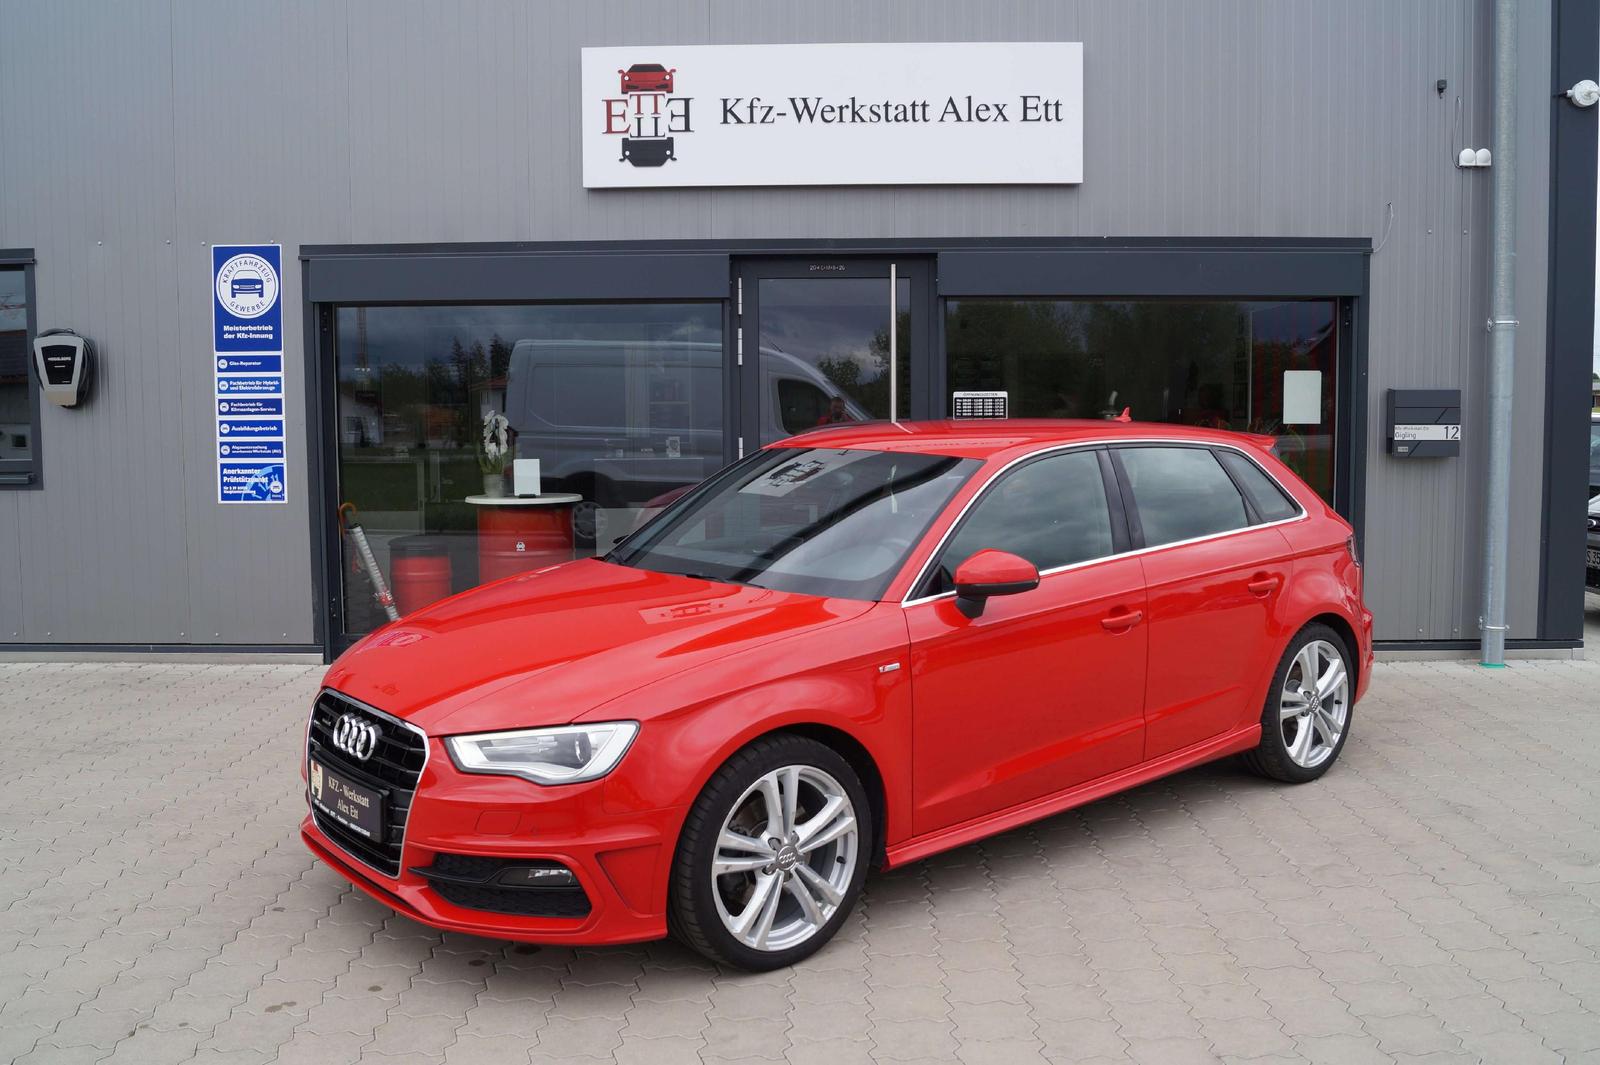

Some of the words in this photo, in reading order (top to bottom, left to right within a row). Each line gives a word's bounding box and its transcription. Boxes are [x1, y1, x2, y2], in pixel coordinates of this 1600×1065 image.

[720, 96, 930, 125] Kfz-Werkstatt
[938, 96, 1009, 123] Alex
[1019, 95, 1064, 122] Ett
[222, 260, 273, 284] KRAFTFAHRZEUG
[230, 301, 266, 312] GEWERBE
[1444, 426, 1459, 439] 12
[328, 776, 339, 793] KFZ
[342, 785, 370, 808] Werkstatt
[337, 799, 349, 815] Alex
[349, 804, 359, 820] Ett
